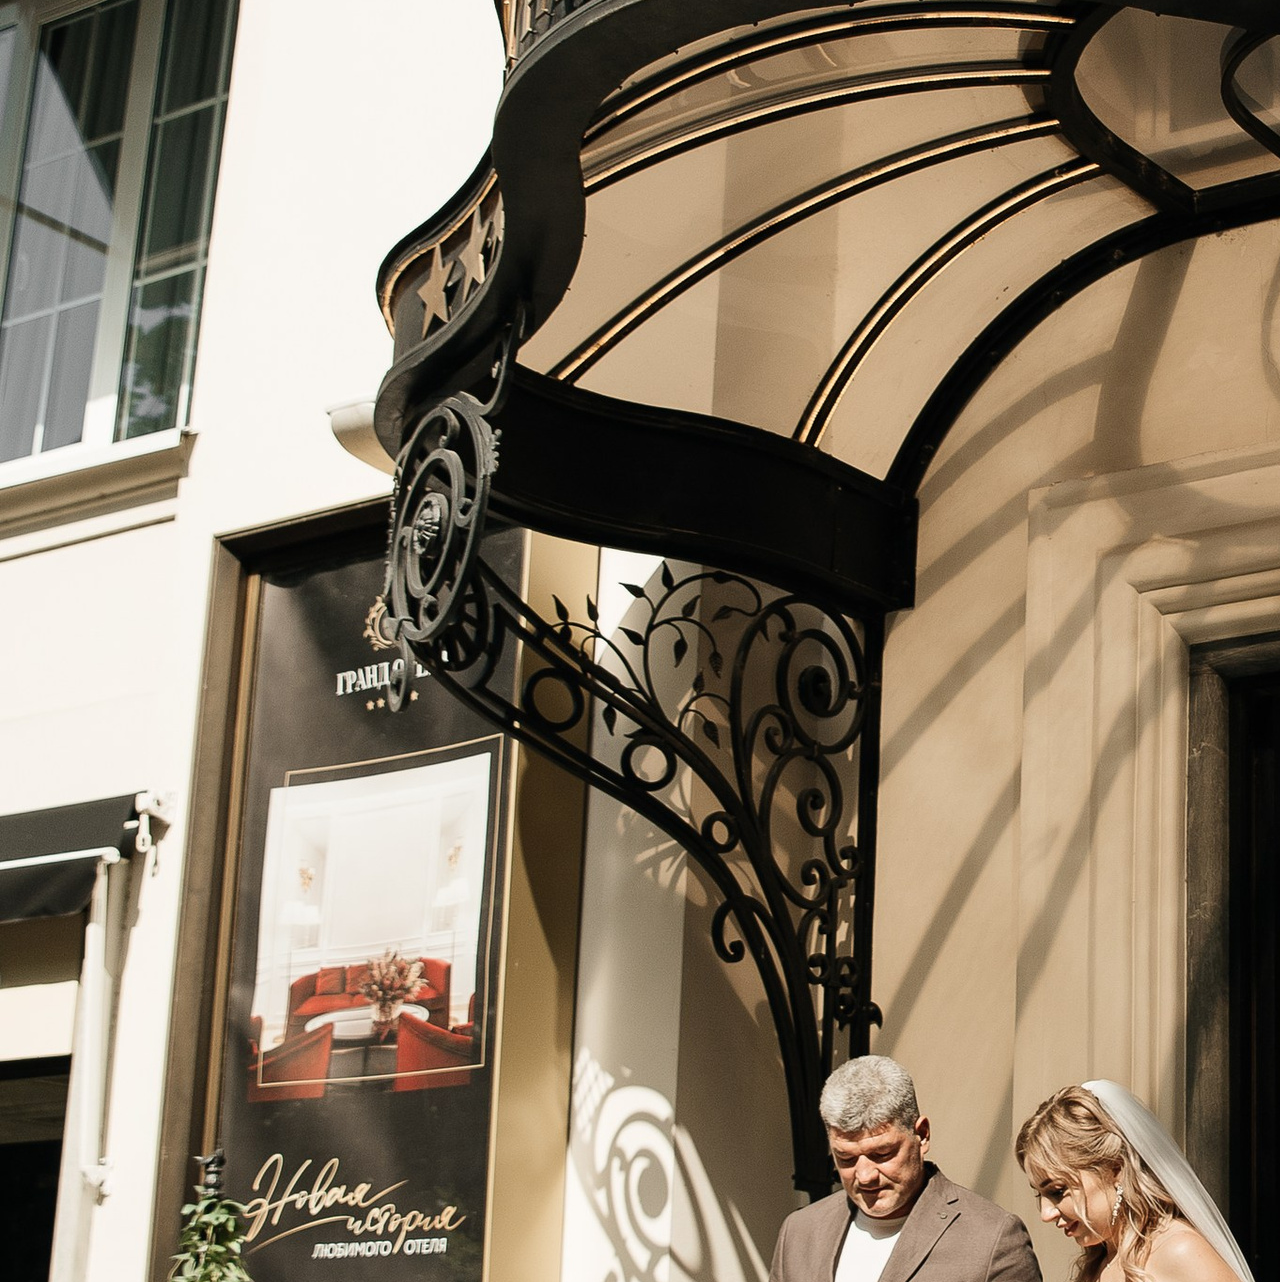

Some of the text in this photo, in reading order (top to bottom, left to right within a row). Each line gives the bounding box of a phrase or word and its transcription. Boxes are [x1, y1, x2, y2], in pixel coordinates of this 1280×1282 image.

[336, 661, 390, 696] ГРАНД
[243, 1154, 409, 1242] Новая
[311, 1237, 448, 1260] ЛЮБИМОГО ОТЕЛЯ
[345, 1204, 467, 1254] история
